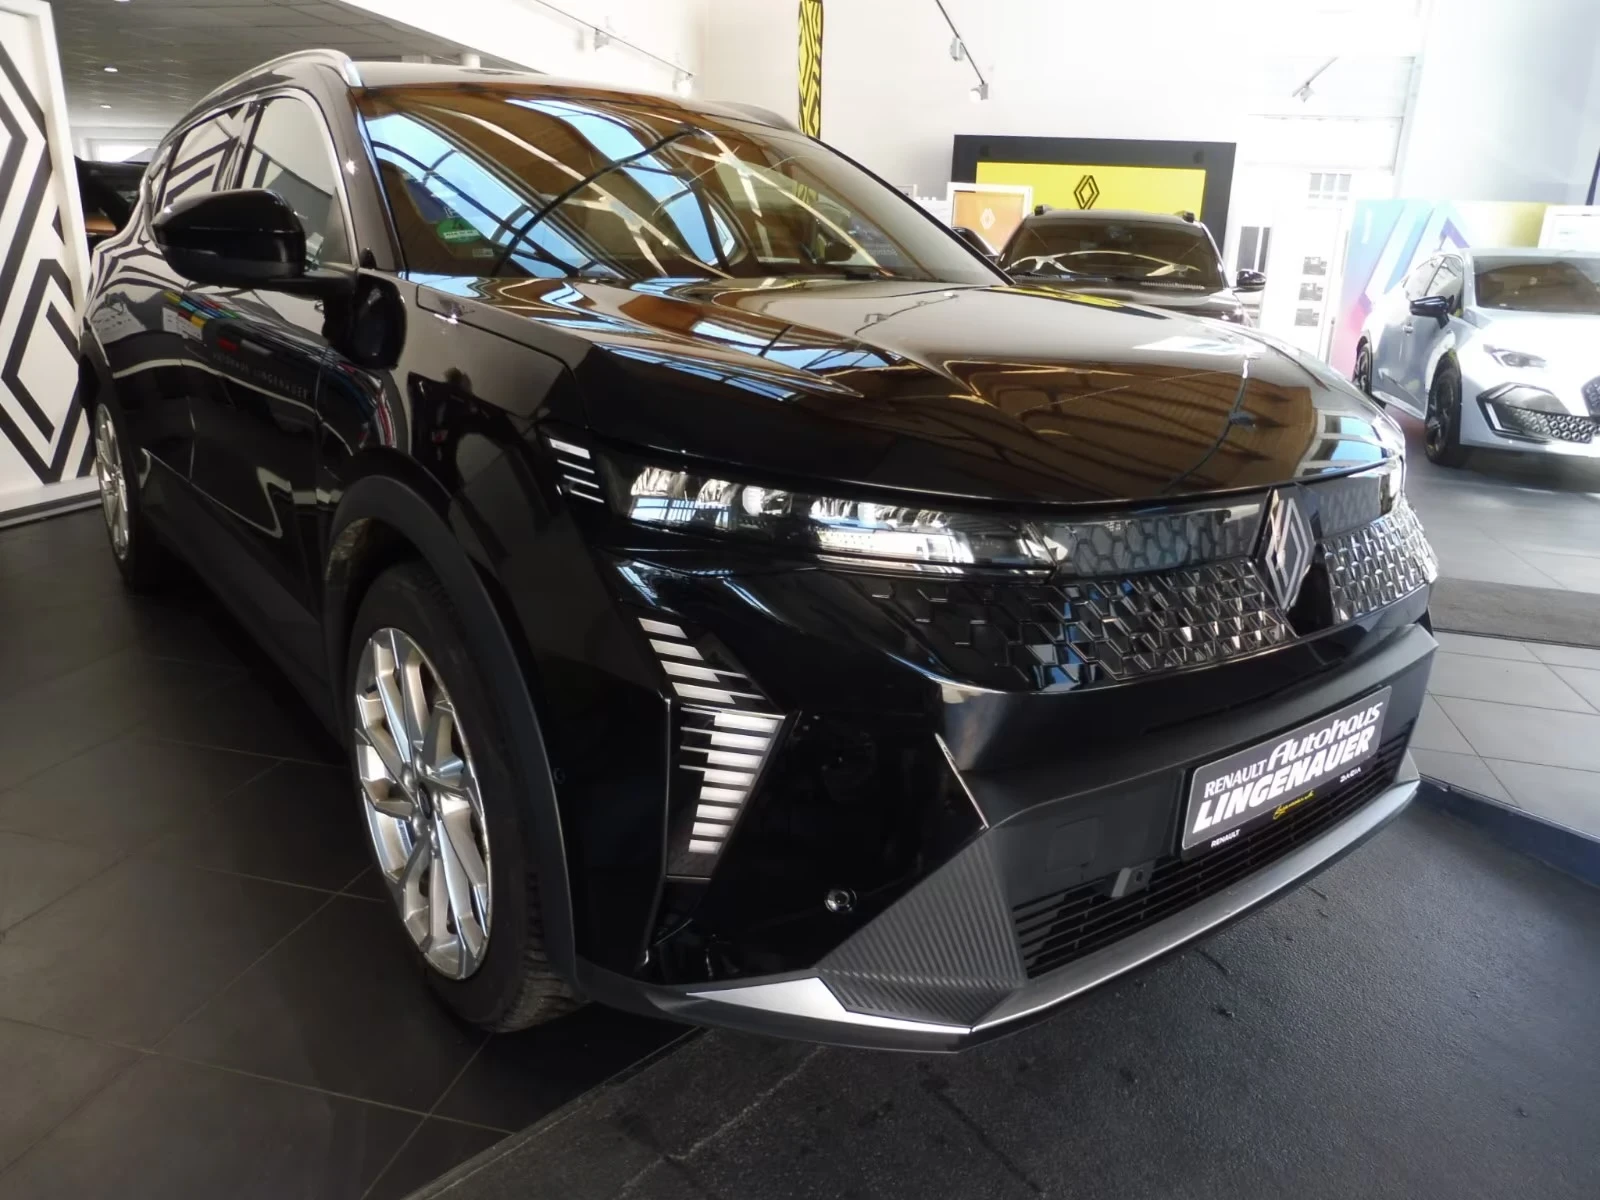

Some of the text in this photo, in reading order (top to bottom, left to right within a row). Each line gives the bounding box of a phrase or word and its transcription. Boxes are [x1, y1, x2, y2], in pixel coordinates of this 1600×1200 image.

[1193, 725, 1375, 834] LINGENAUER
[1204, 758, 1268, 798] RENAULT
[1210, 828, 1241, 848] RENAULT
